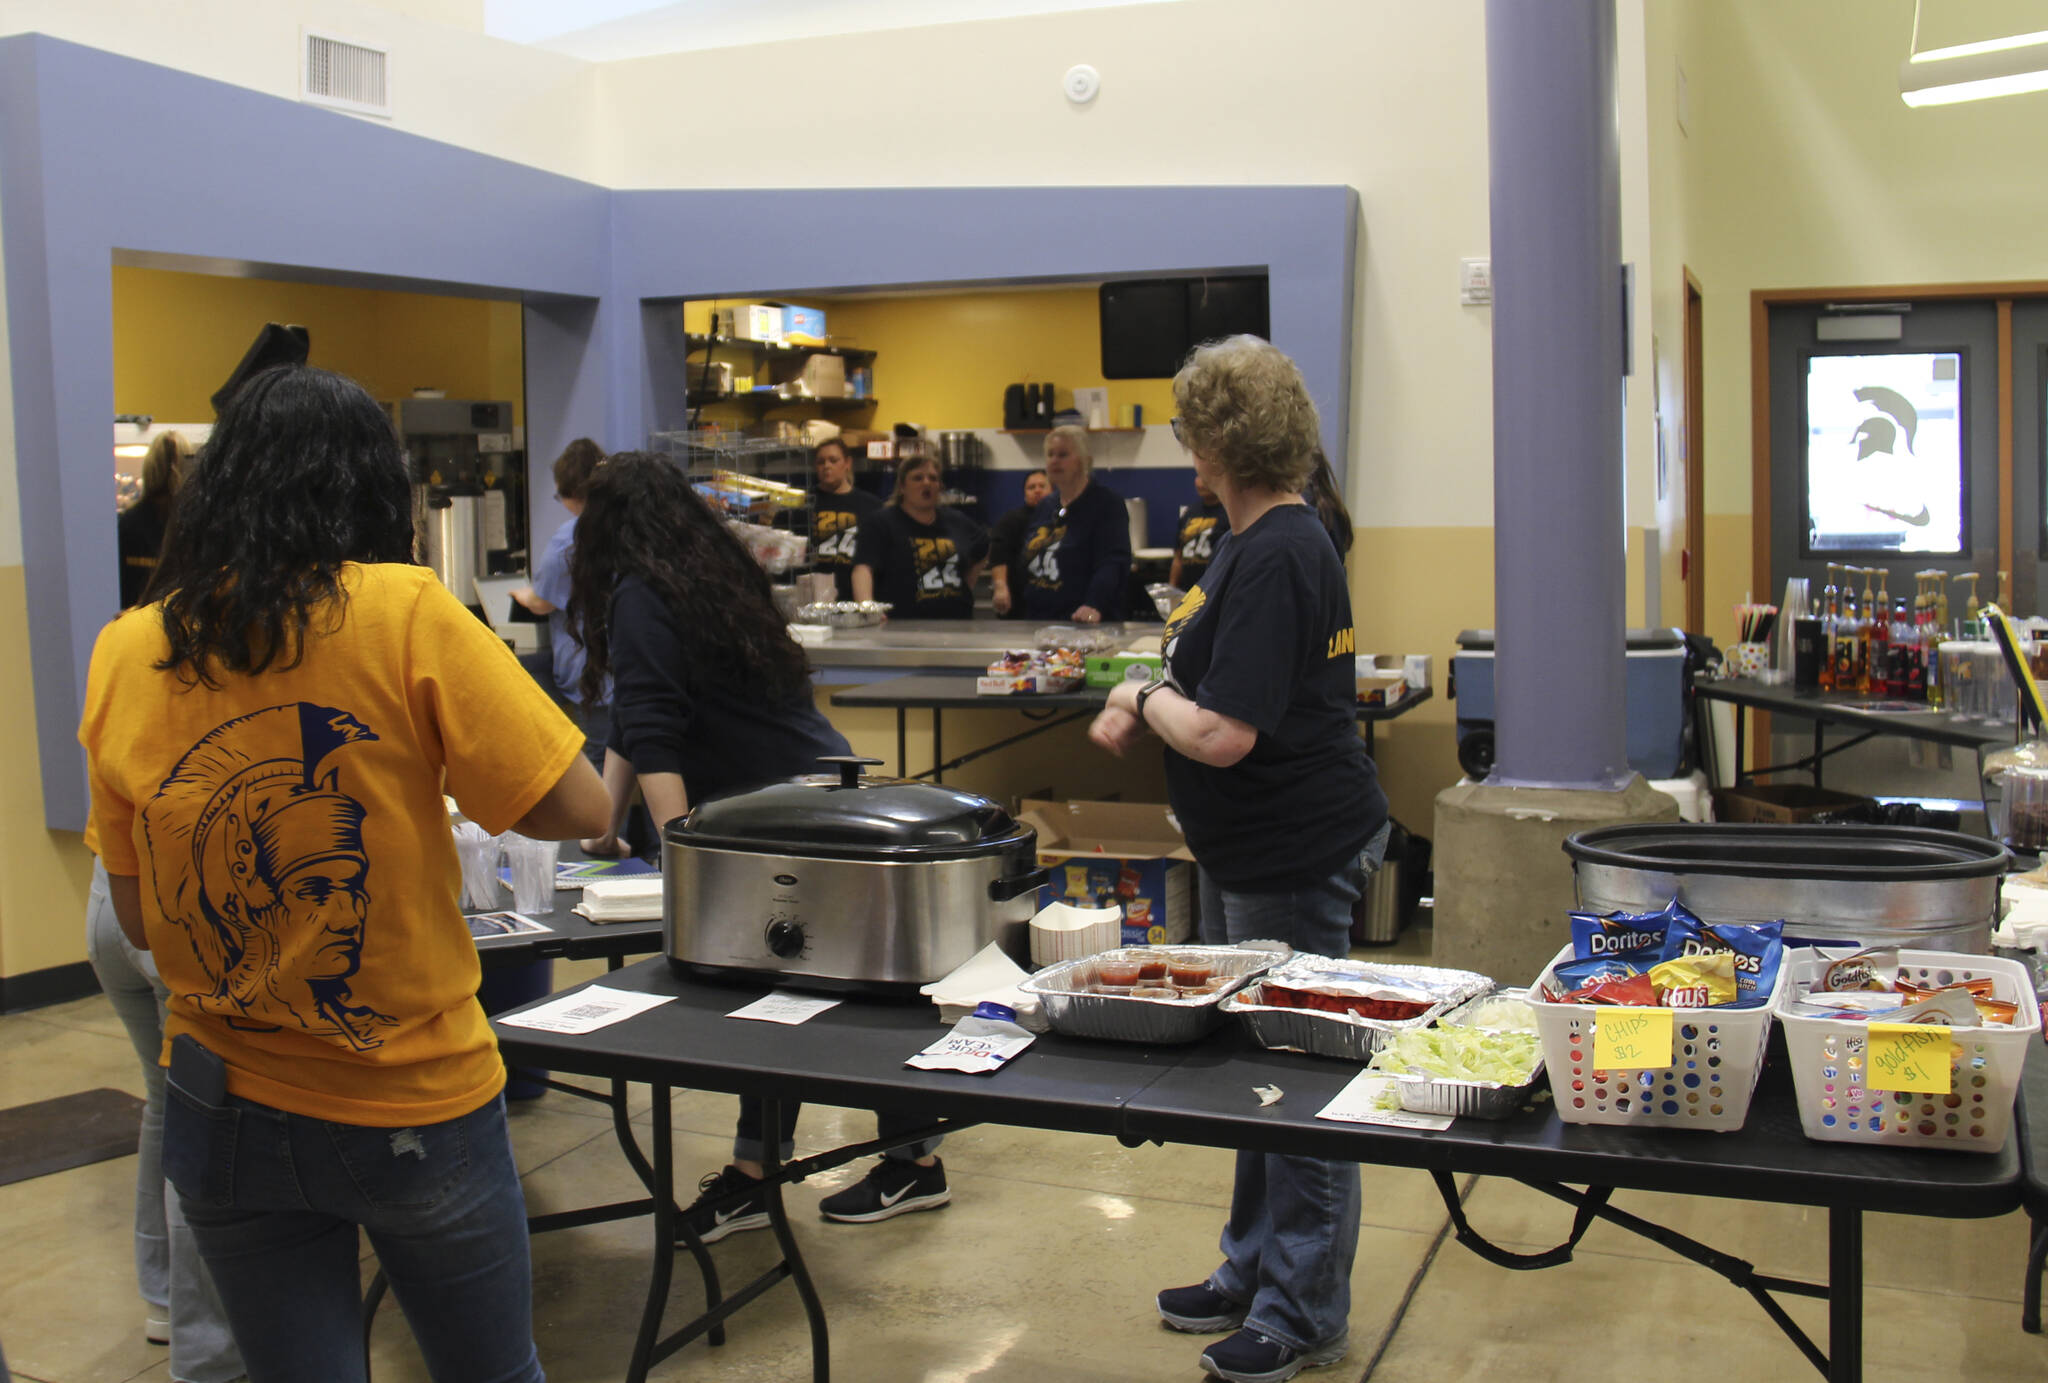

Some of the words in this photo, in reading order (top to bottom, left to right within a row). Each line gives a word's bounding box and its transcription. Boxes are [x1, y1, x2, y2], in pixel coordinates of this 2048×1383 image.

[818, 525, 858, 557] 24
[922, 552, 962, 589] 24
[1591, 929, 1663, 954] Doritos
[1831, 964, 1876, 988] Goldfis
[1661, 984, 1708, 1008] Lay's
[1605, 1013, 1648, 1042] CHIPS
[1614, 1044, 1642, 1060] $2
[1904, 1061, 1930, 1081] $1
